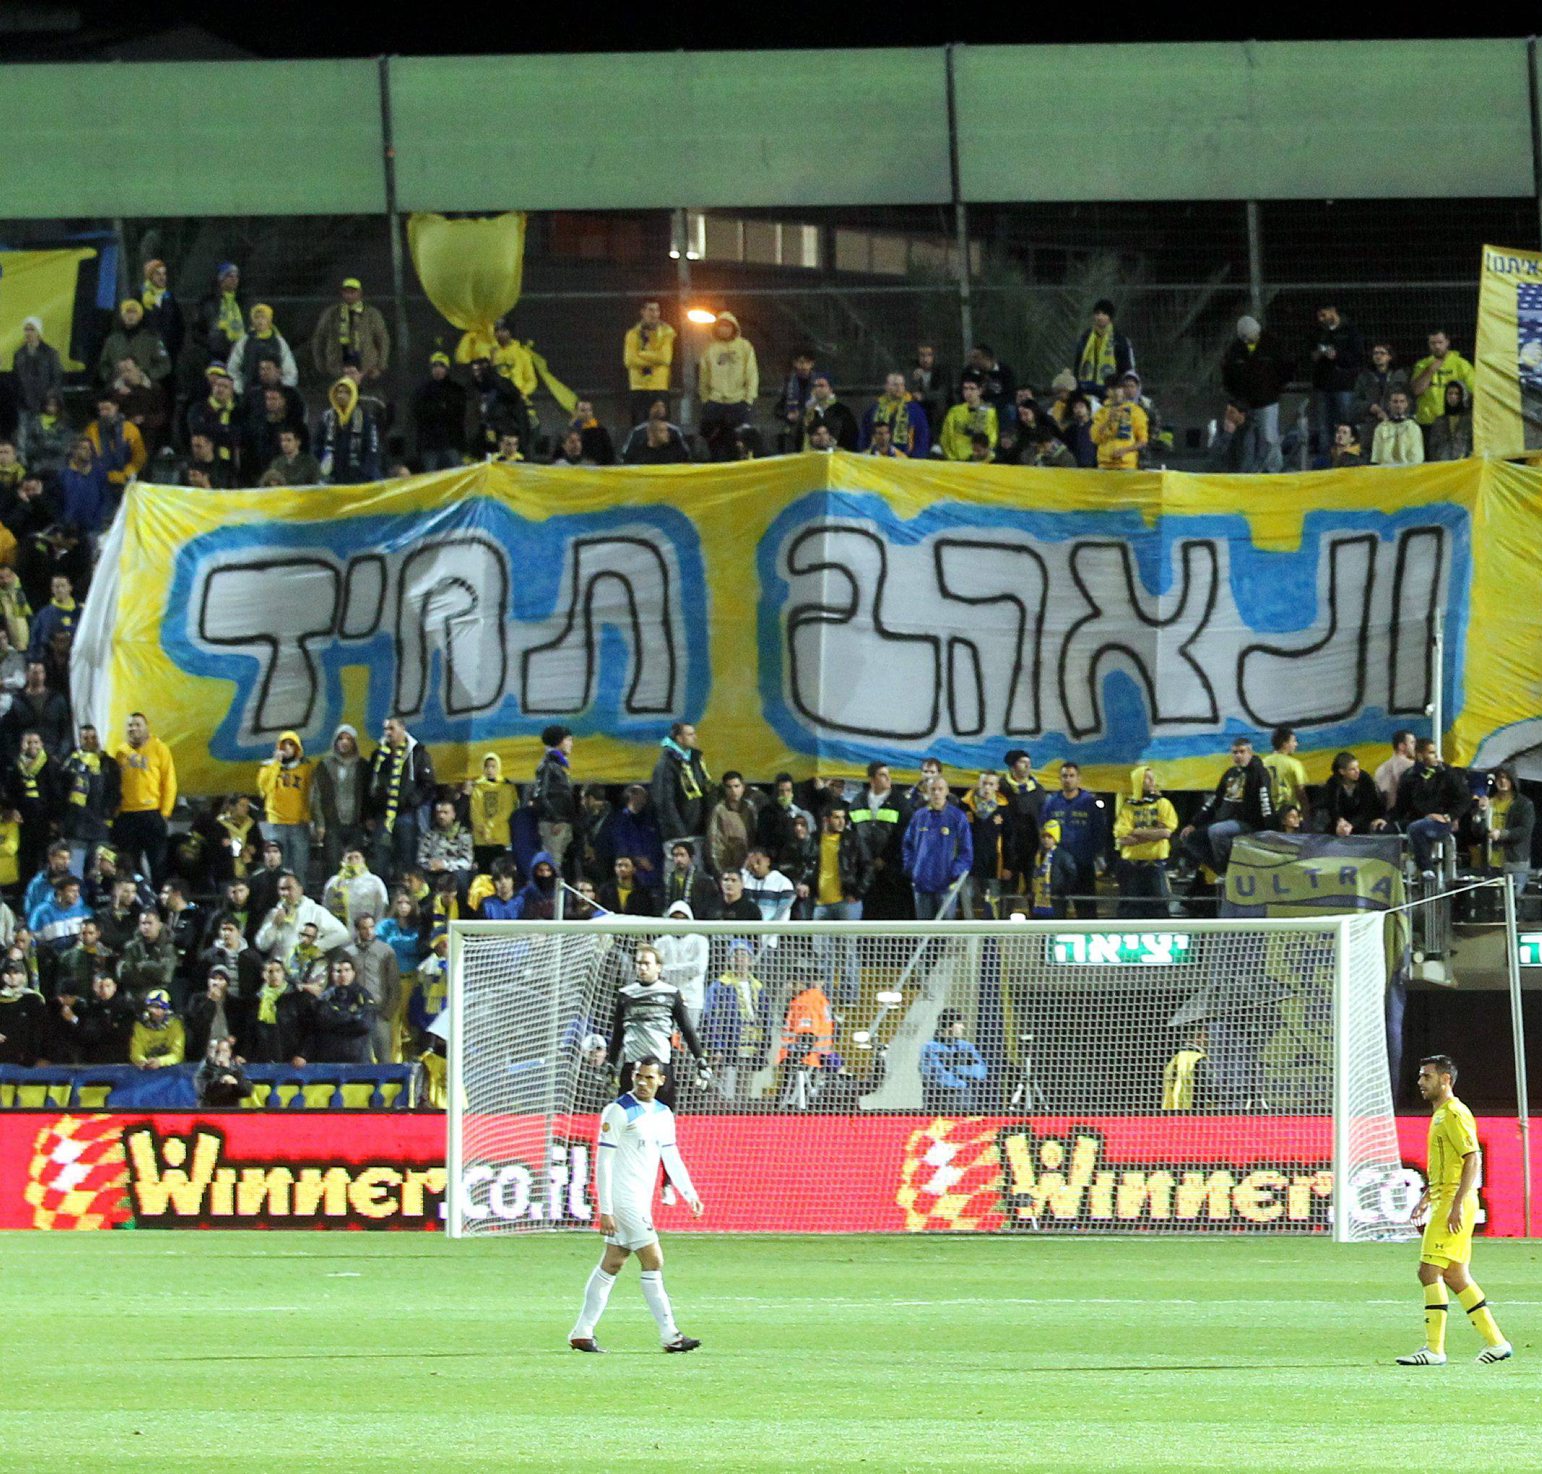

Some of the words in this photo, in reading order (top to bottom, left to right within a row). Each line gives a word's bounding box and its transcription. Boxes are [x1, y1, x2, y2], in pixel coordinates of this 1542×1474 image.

[198, 524, 678, 734] תמיד
[787, 524, 1444, 739] ונאהב
[1234, 865, 1393, 899] ULTRA
[1055, 933, 1190, 964] יציאה
